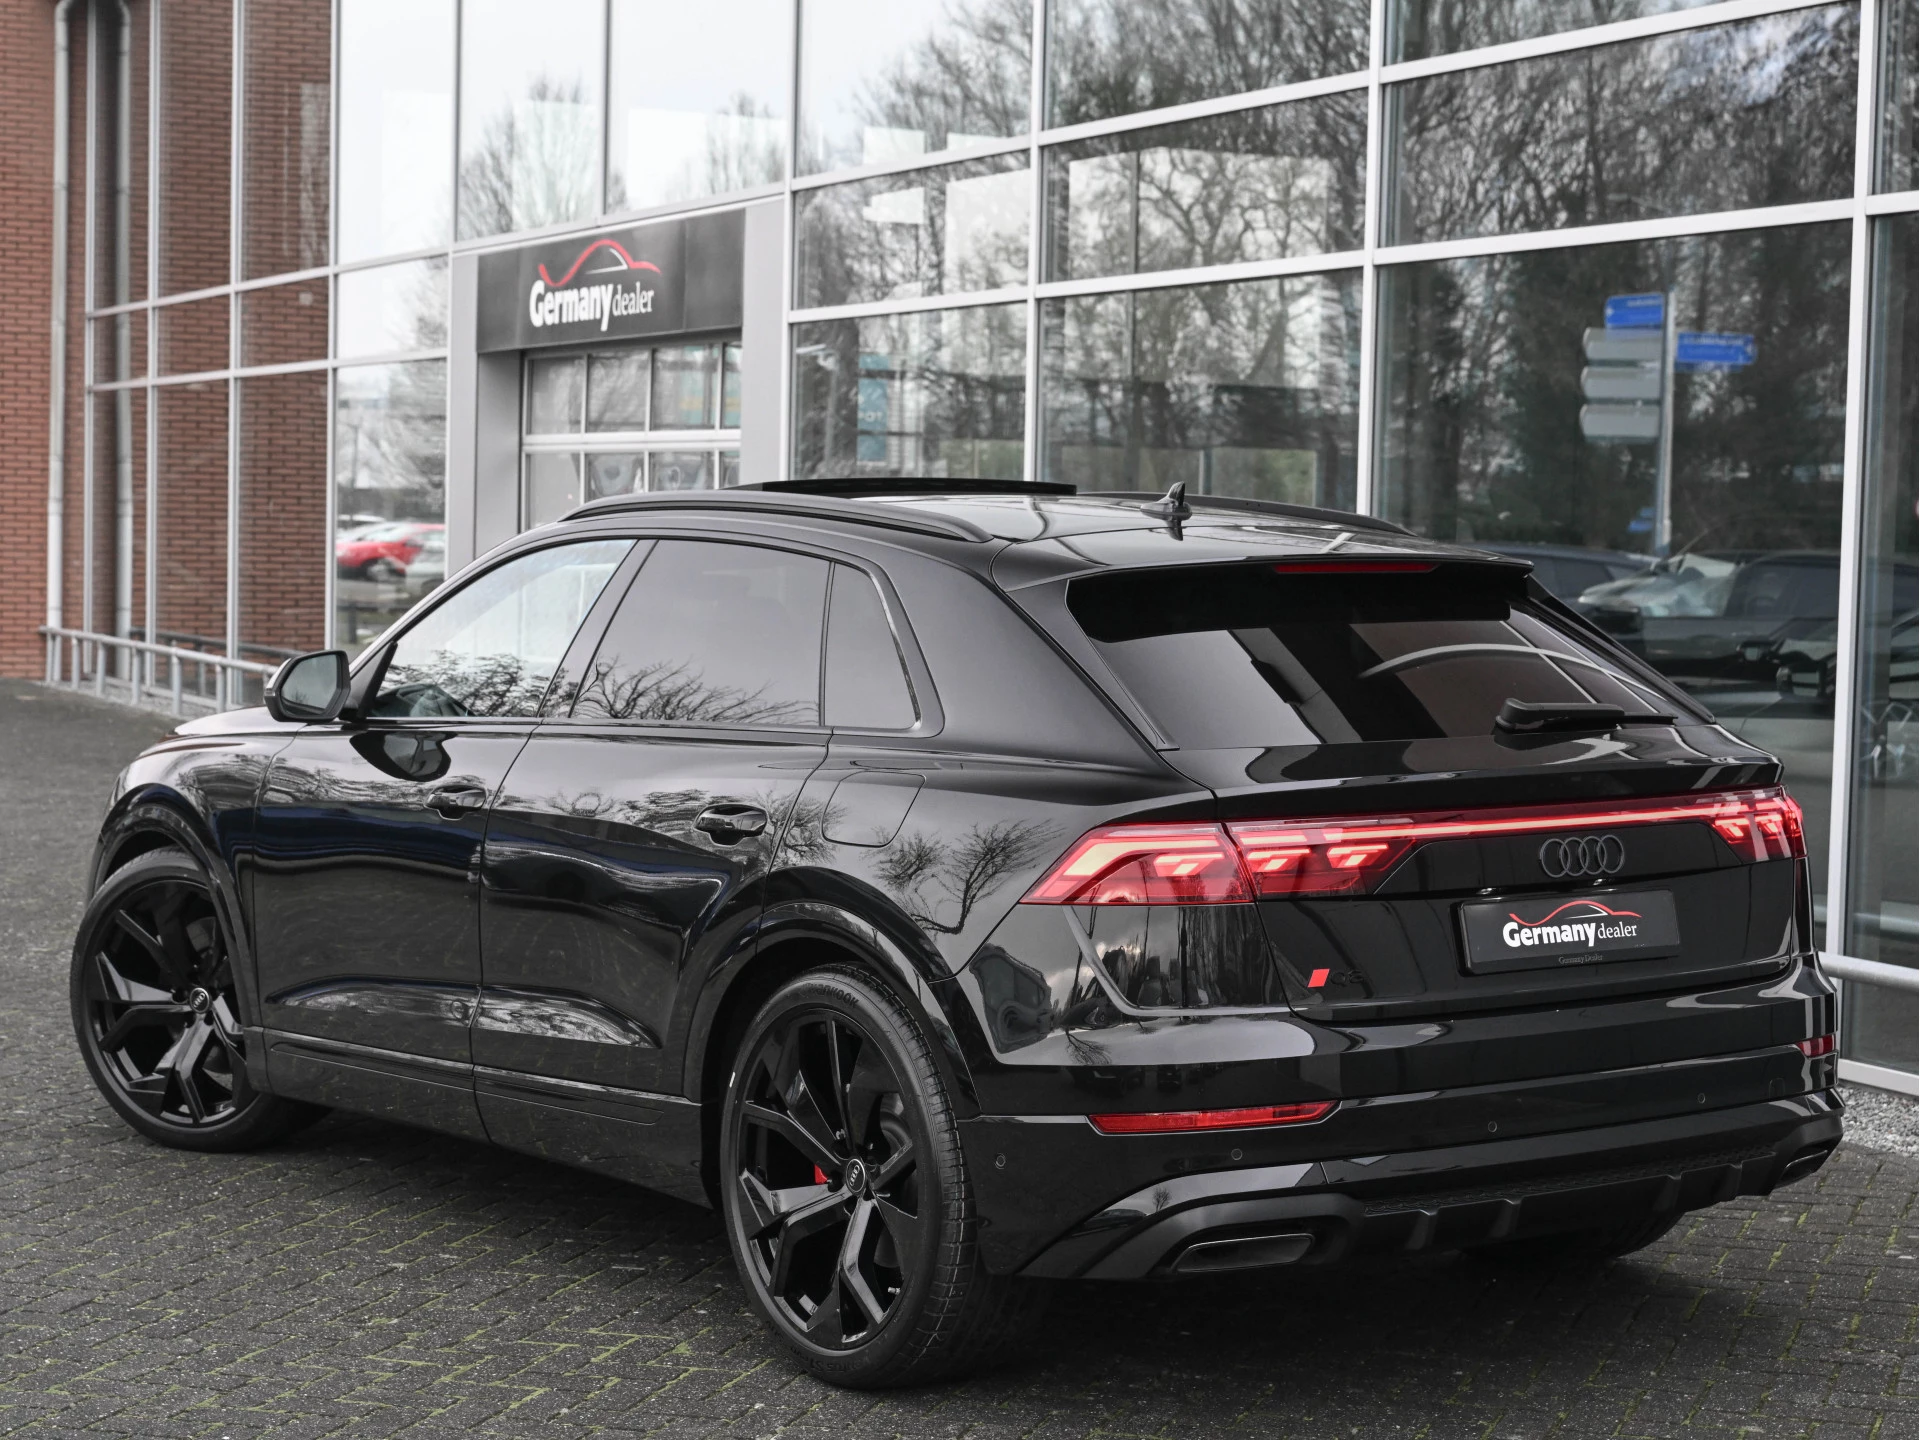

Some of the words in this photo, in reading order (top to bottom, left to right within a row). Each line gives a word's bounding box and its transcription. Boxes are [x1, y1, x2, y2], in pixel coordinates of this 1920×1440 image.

[529, 279, 614, 332] Germany
[612, 281, 655, 317] dealer
[1503, 921, 1596, 947] Germany
[1598, 921, 1637, 939] dealer
[1558, 955, 1584, 965] Germany
[1585, 953, 1603, 963] Dealer
